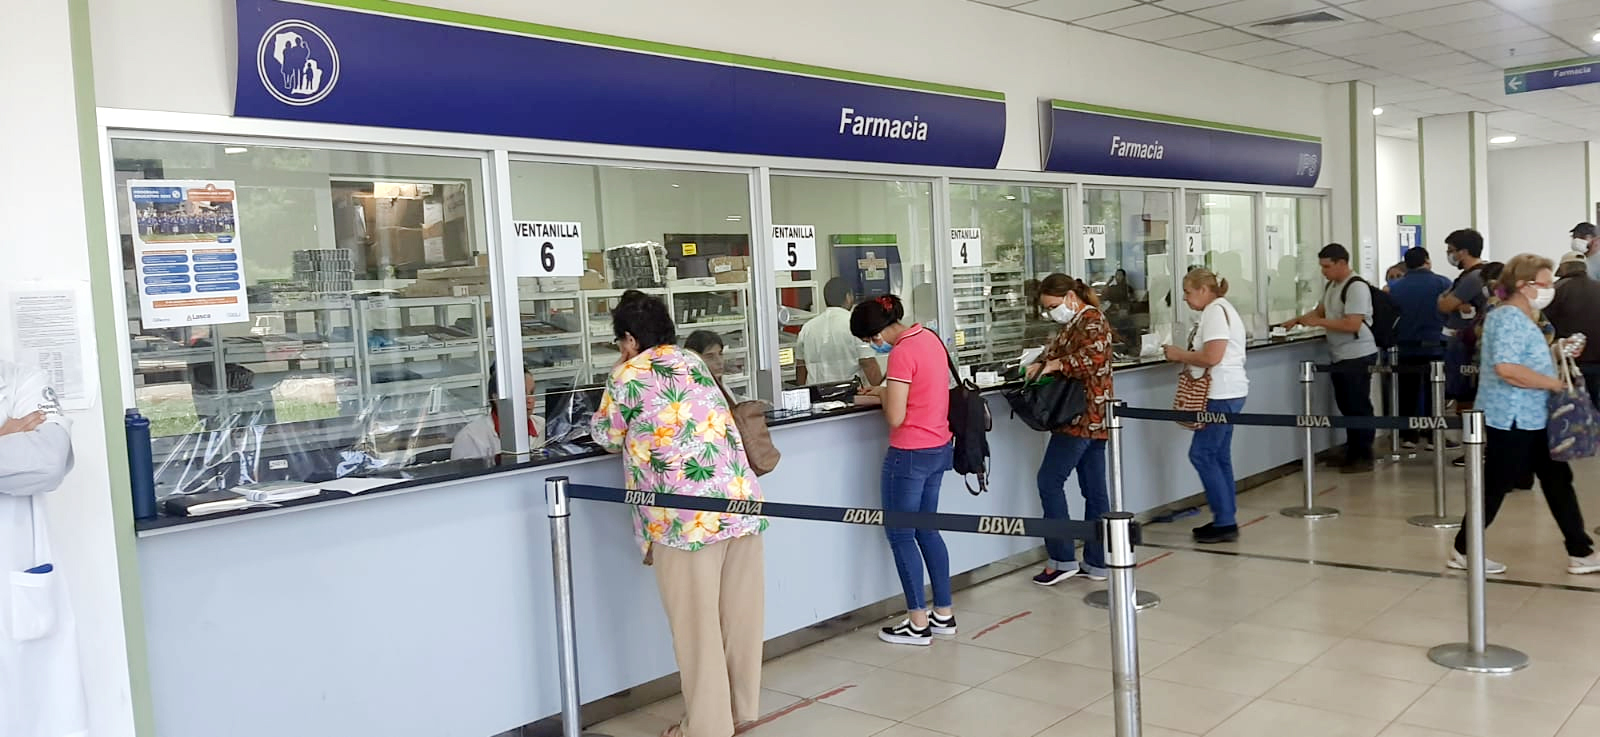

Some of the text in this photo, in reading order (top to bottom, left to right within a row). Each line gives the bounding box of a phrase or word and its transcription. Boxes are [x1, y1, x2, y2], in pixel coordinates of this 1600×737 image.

[839, 107, 928, 141] Farmacia
[1110, 135, 1164, 160] Farmacia
[514, 223, 579, 238] VENTANILLA
[951, 229, 979, 240] ENTANILLA
[960, 242, 968, 264] 4
[1089, 237, 1095, 257] 3
[1189, 236, 1194, 253] 2
[540, 241, 555, 273] 6
[787, 242, 797, 267] 5
[1460, 364, 1481, 375] BBV
[1196, 412, 1228, 424] BBVA
[1296, 415, 1331, 428] BBVA
[1408, 416, 1448, 429] BBVA
[624, 490, 656, 506] BBVA
[726, 500, 763, 515] BBVA
[842, 508, 884, 525] BBVA
[978, 516, 1026, 536] BBVA
